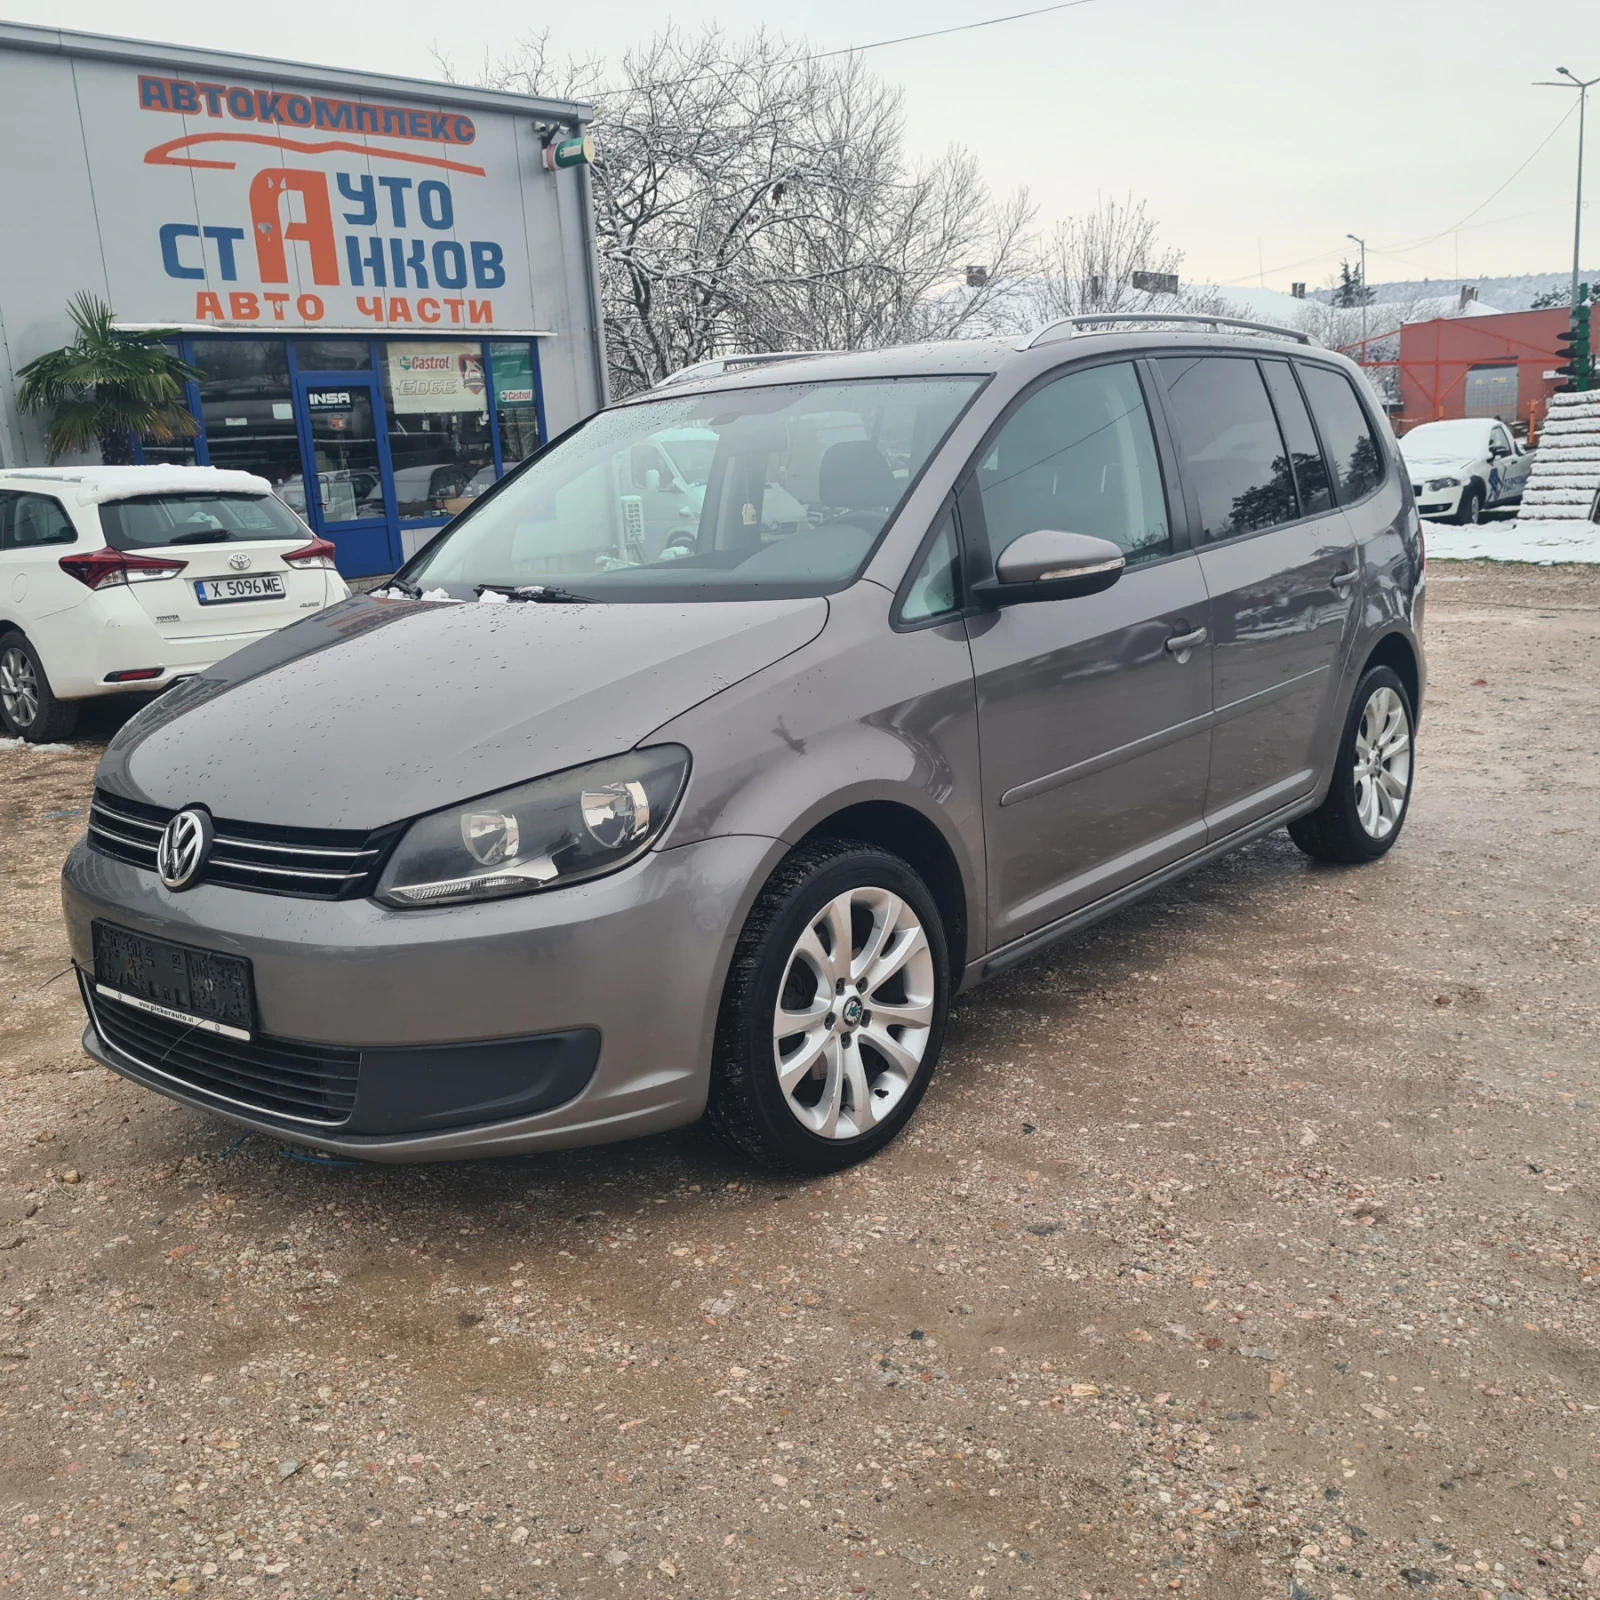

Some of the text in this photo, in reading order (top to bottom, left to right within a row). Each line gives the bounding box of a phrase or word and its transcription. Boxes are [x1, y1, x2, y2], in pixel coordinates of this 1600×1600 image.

[139, 76, 475, 145] АВТОКОМПЛЕКС
[195, 291, 494, 324] АВТО ЧАСТИ
[411, 355, 450, 370] Castrol
[398, 379, 458, 396] EDGE
[507, 390, 531, 401] Castrol
[309, 392, 351, 405] INSA
[227, 579, 262, 596] 5096
[155, 614, 180, 622] TOYOTA
